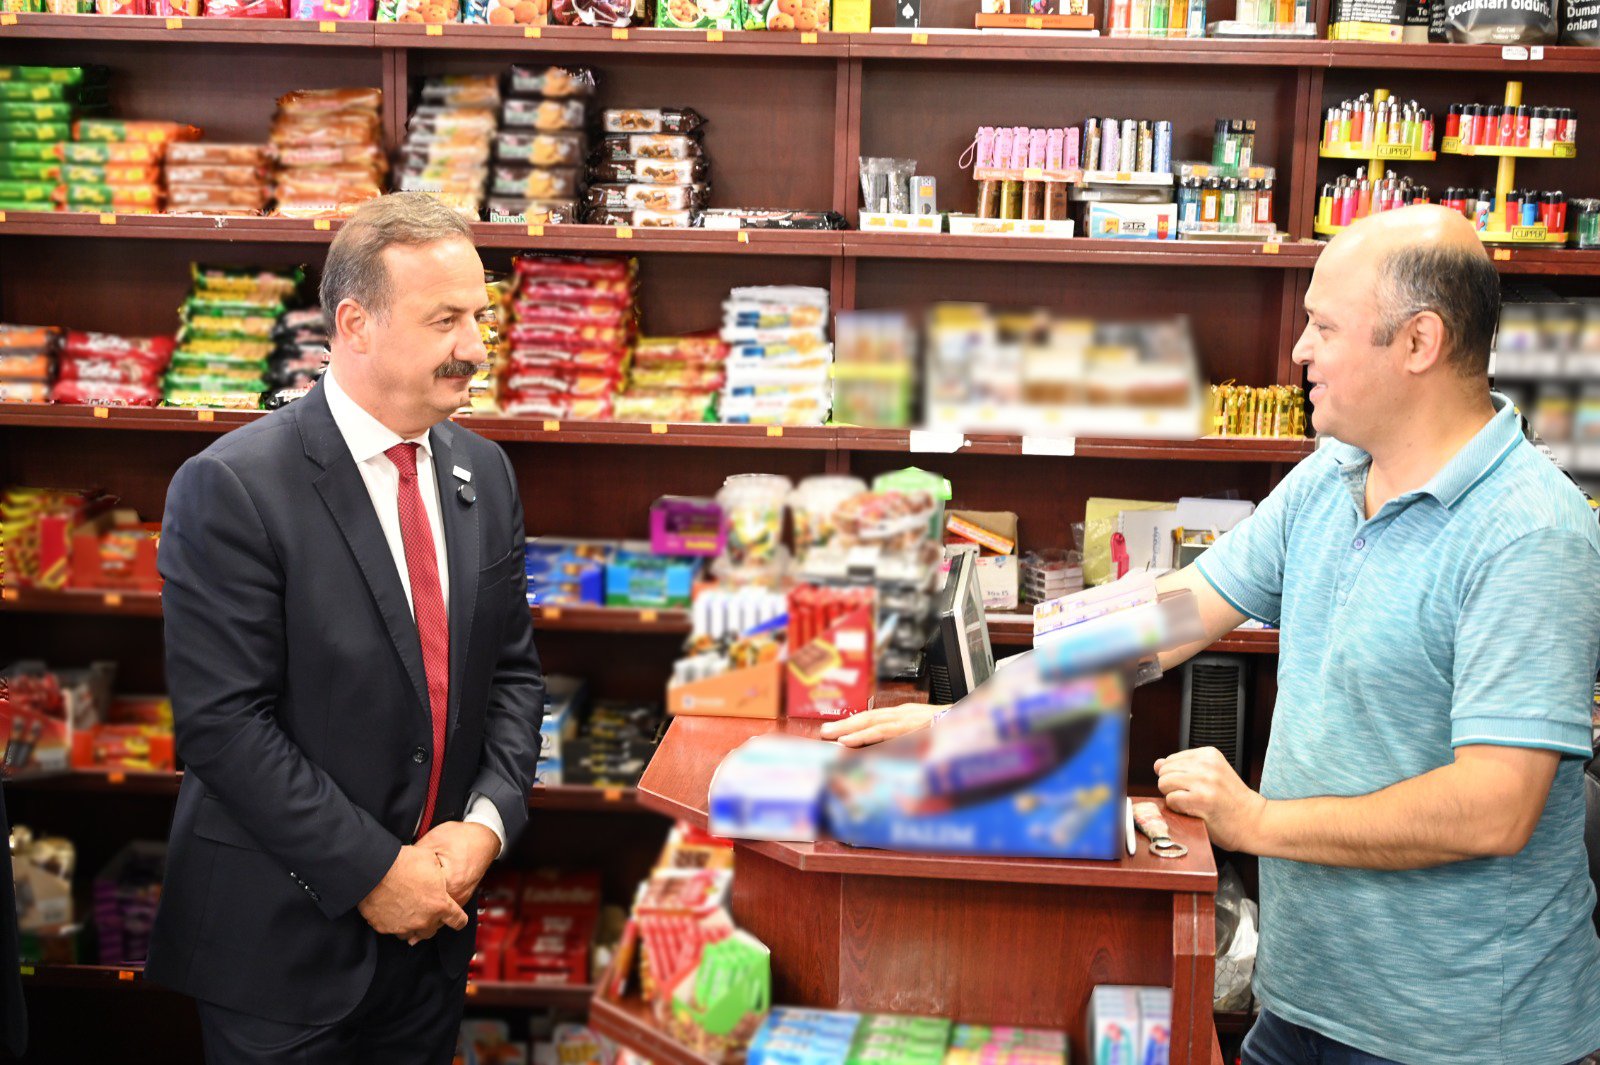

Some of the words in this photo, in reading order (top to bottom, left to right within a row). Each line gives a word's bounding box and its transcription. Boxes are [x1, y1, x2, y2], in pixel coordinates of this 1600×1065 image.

[1567, 18, 1598, 31] onlara
[1380, 147, 1409, 156] CLIPPER
[1515, 230, 1544, 238] CLIPPER
